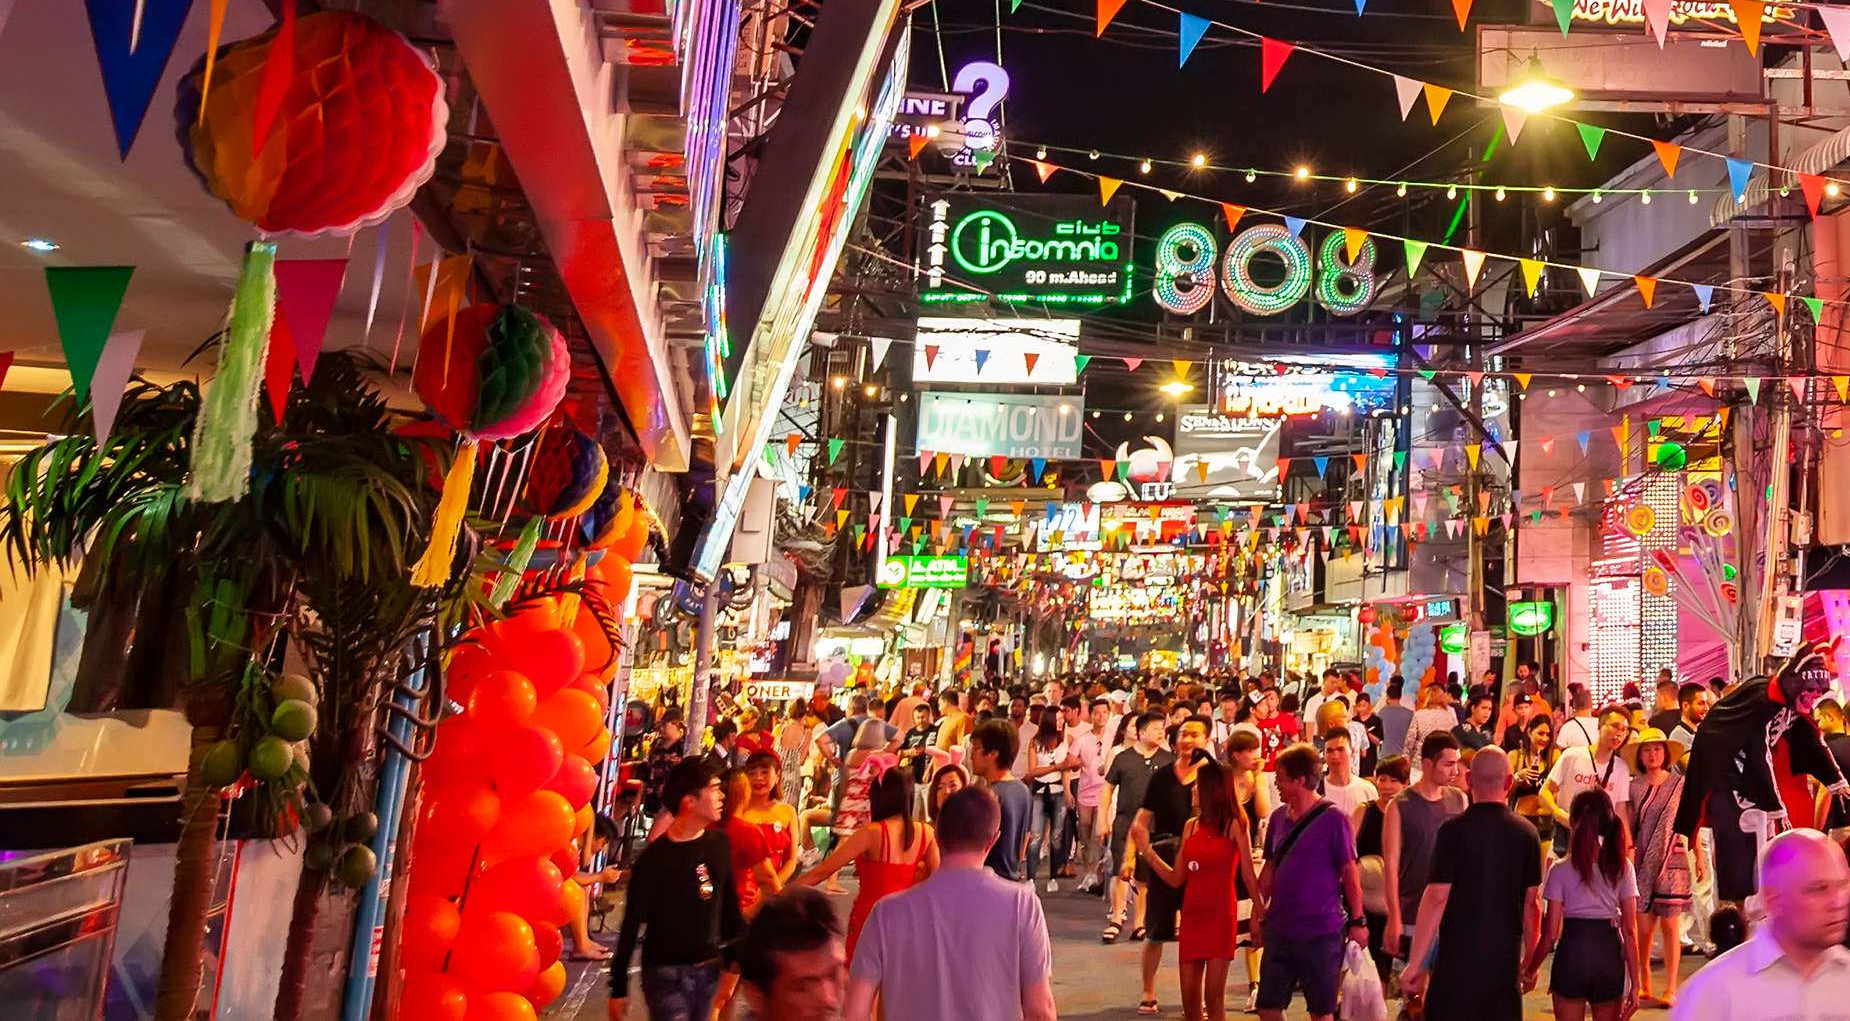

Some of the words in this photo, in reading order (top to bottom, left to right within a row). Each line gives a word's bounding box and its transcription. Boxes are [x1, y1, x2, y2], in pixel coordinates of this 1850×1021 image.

[1153, 221, 1378, 317] 808
[920, 398, 1083, 443] DIAMOND
[1009, 444, 1075, 459] HOTEL
